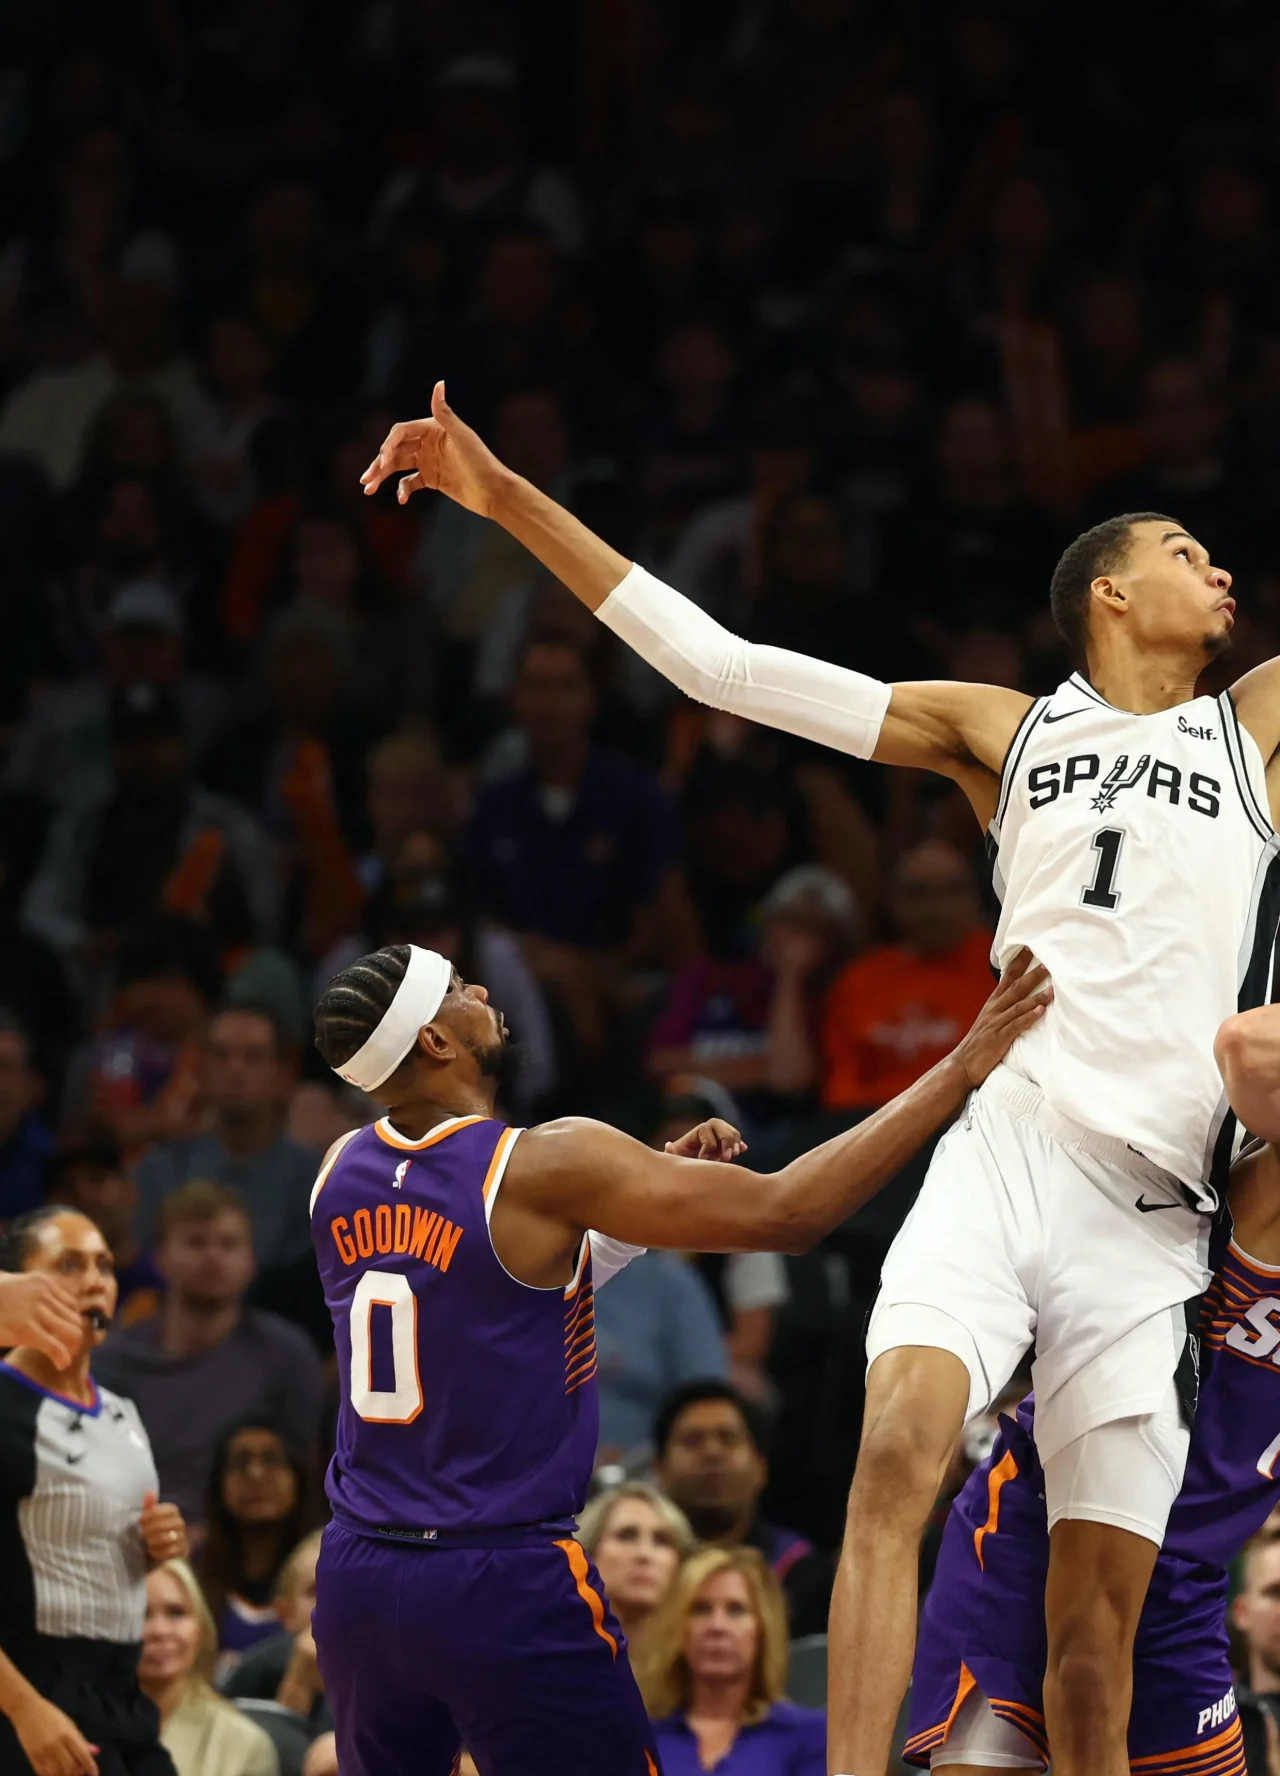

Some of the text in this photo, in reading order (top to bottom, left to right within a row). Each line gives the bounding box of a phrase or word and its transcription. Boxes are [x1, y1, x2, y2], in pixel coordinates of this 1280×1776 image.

[1177, 716, 1217, 741] Self.
[1028, 754, 1221, 819] SPURS
[1078, 826, 1126, 913] 1
[331, 1205, 463, 1272] GOODWIN
[350, 1270, 424, 1424] 0
